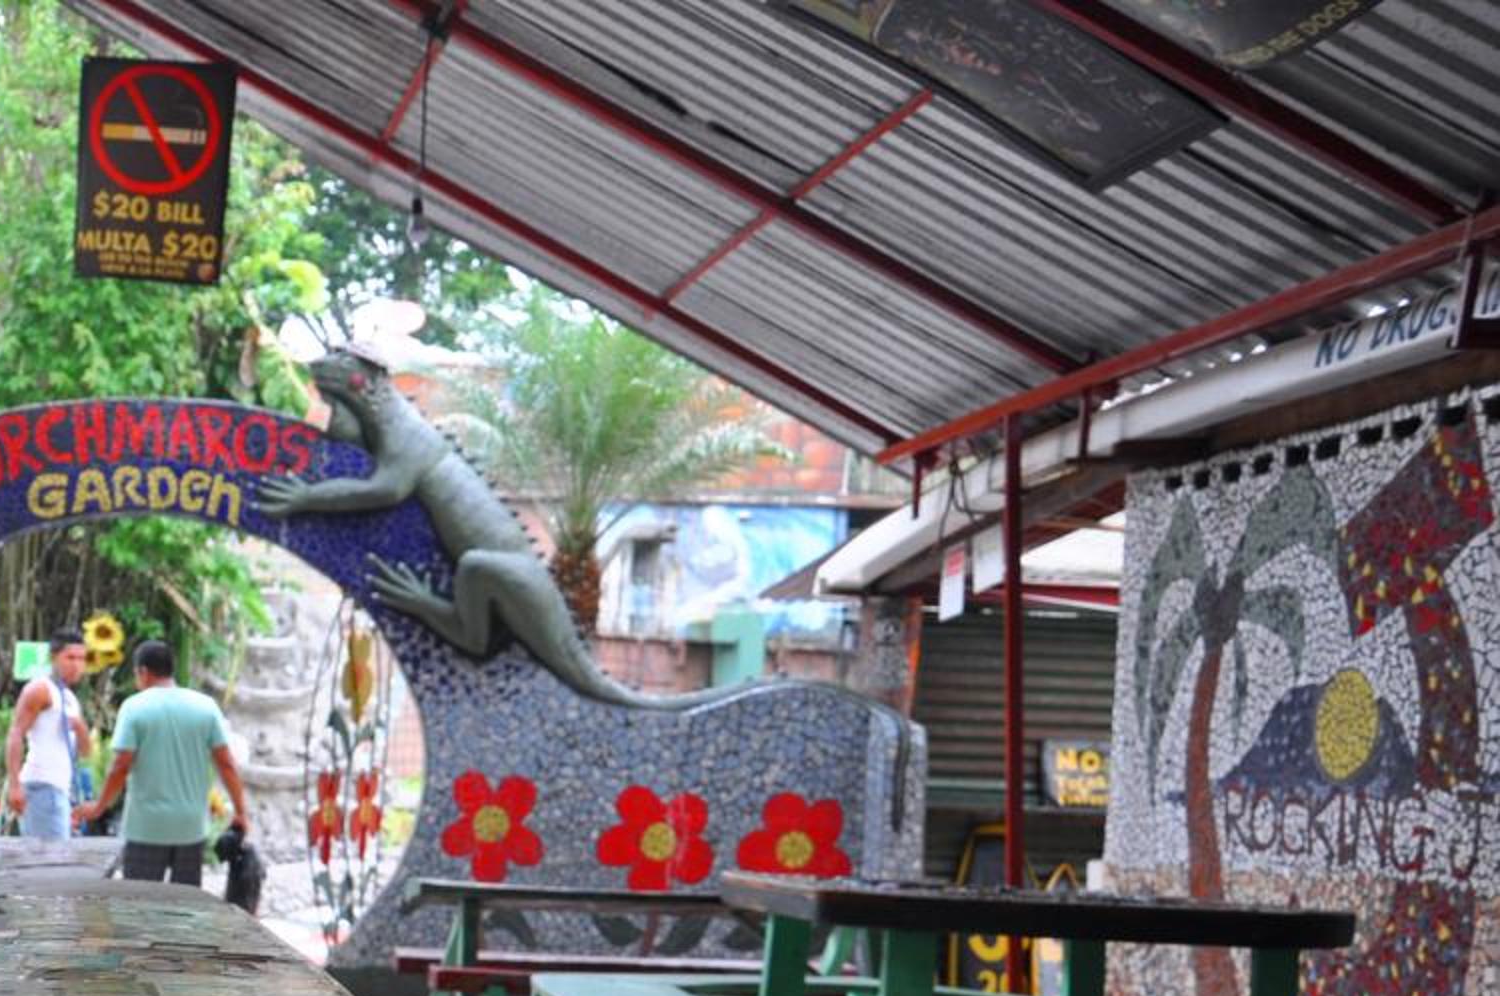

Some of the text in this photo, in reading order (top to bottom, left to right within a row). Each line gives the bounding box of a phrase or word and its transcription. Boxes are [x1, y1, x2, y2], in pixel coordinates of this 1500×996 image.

[92, 190, 205, 225] $20 BILL
[77, 229, 152, 254] MULTA
[162, 229, 218, 260] $20
[1315, 322, 1361, 367] NO
[1370, 287, 1457, 350] DRUG
[1055, 748, 1102, 774] NO
[1222, 783, 1435, 880] ROCKING
